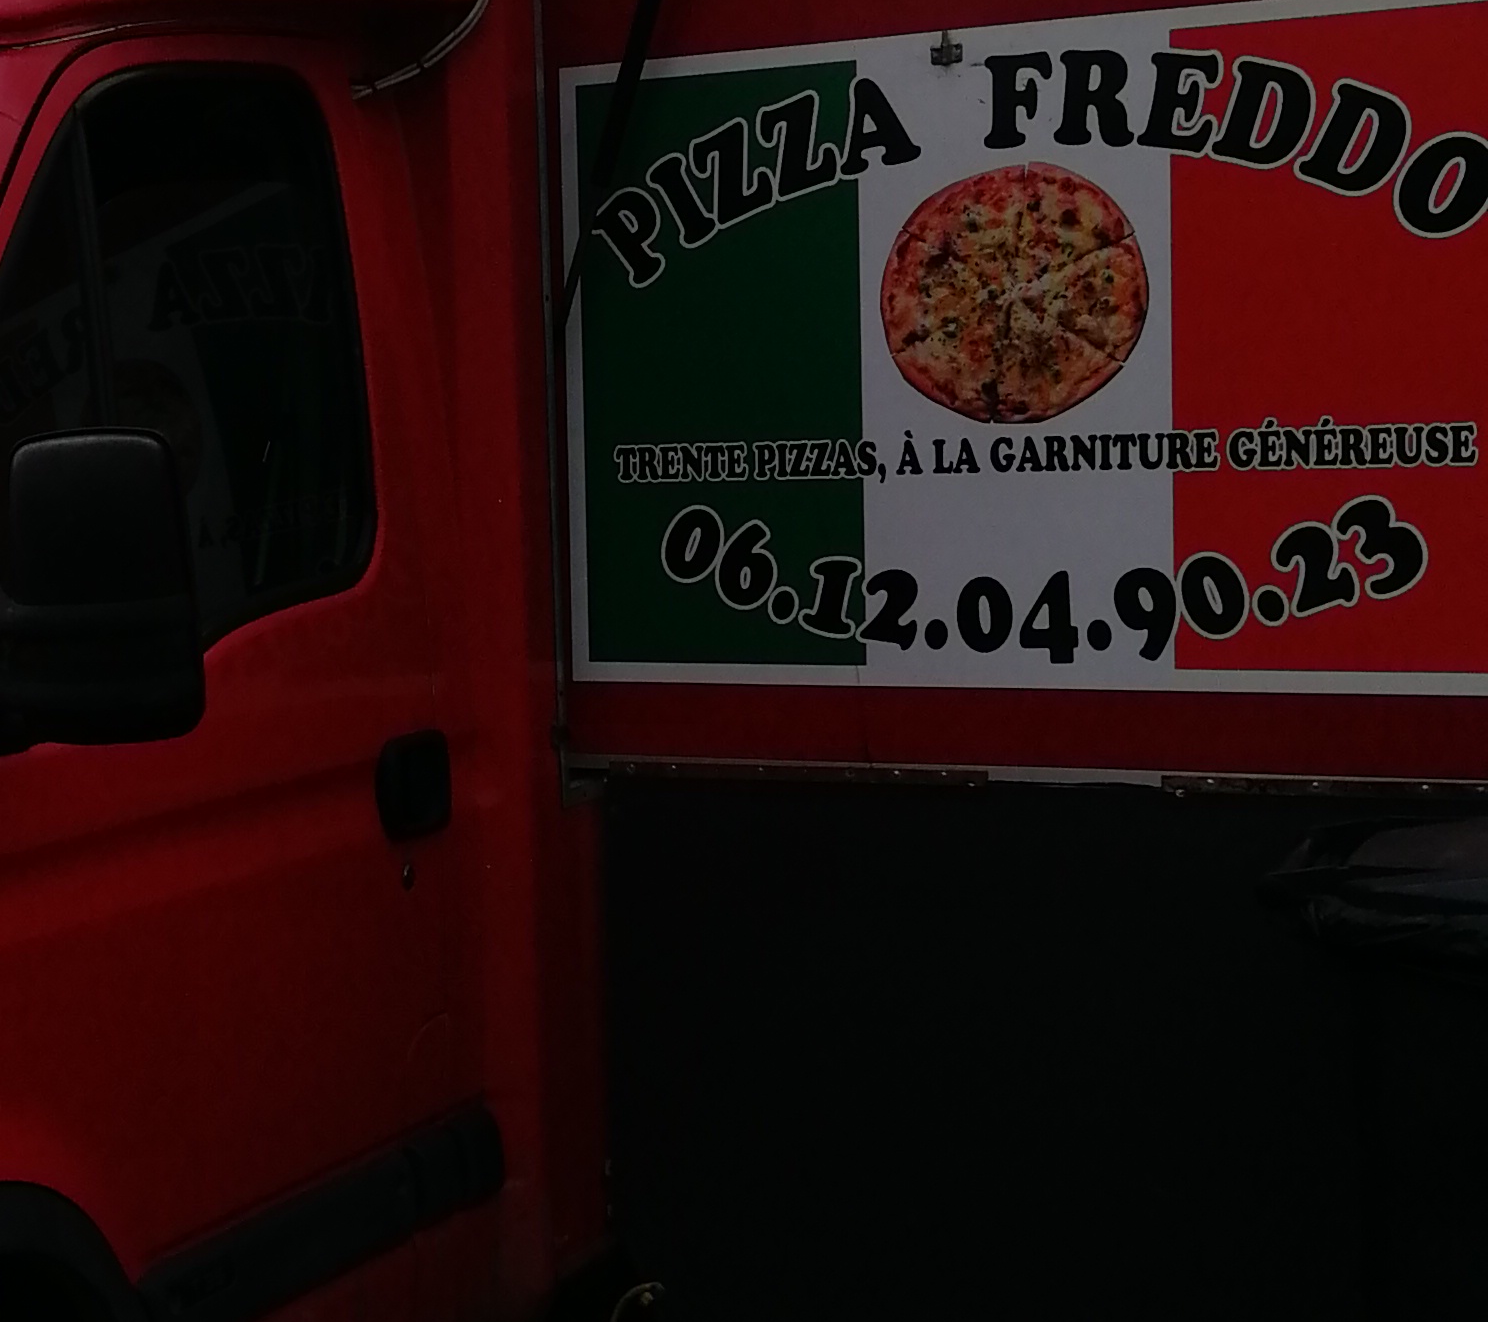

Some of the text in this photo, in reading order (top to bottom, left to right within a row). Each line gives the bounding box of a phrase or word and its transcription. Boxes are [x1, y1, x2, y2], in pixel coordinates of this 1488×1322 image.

[593, 49, 1488, 289] PIZZA FREDDO
[614, 416, 1478, 484] TRENTE PIZZAS, À LA GARNITURE GÉNÉREUSE
[661, 495, 1429, 665] 06.12.04.90.23
